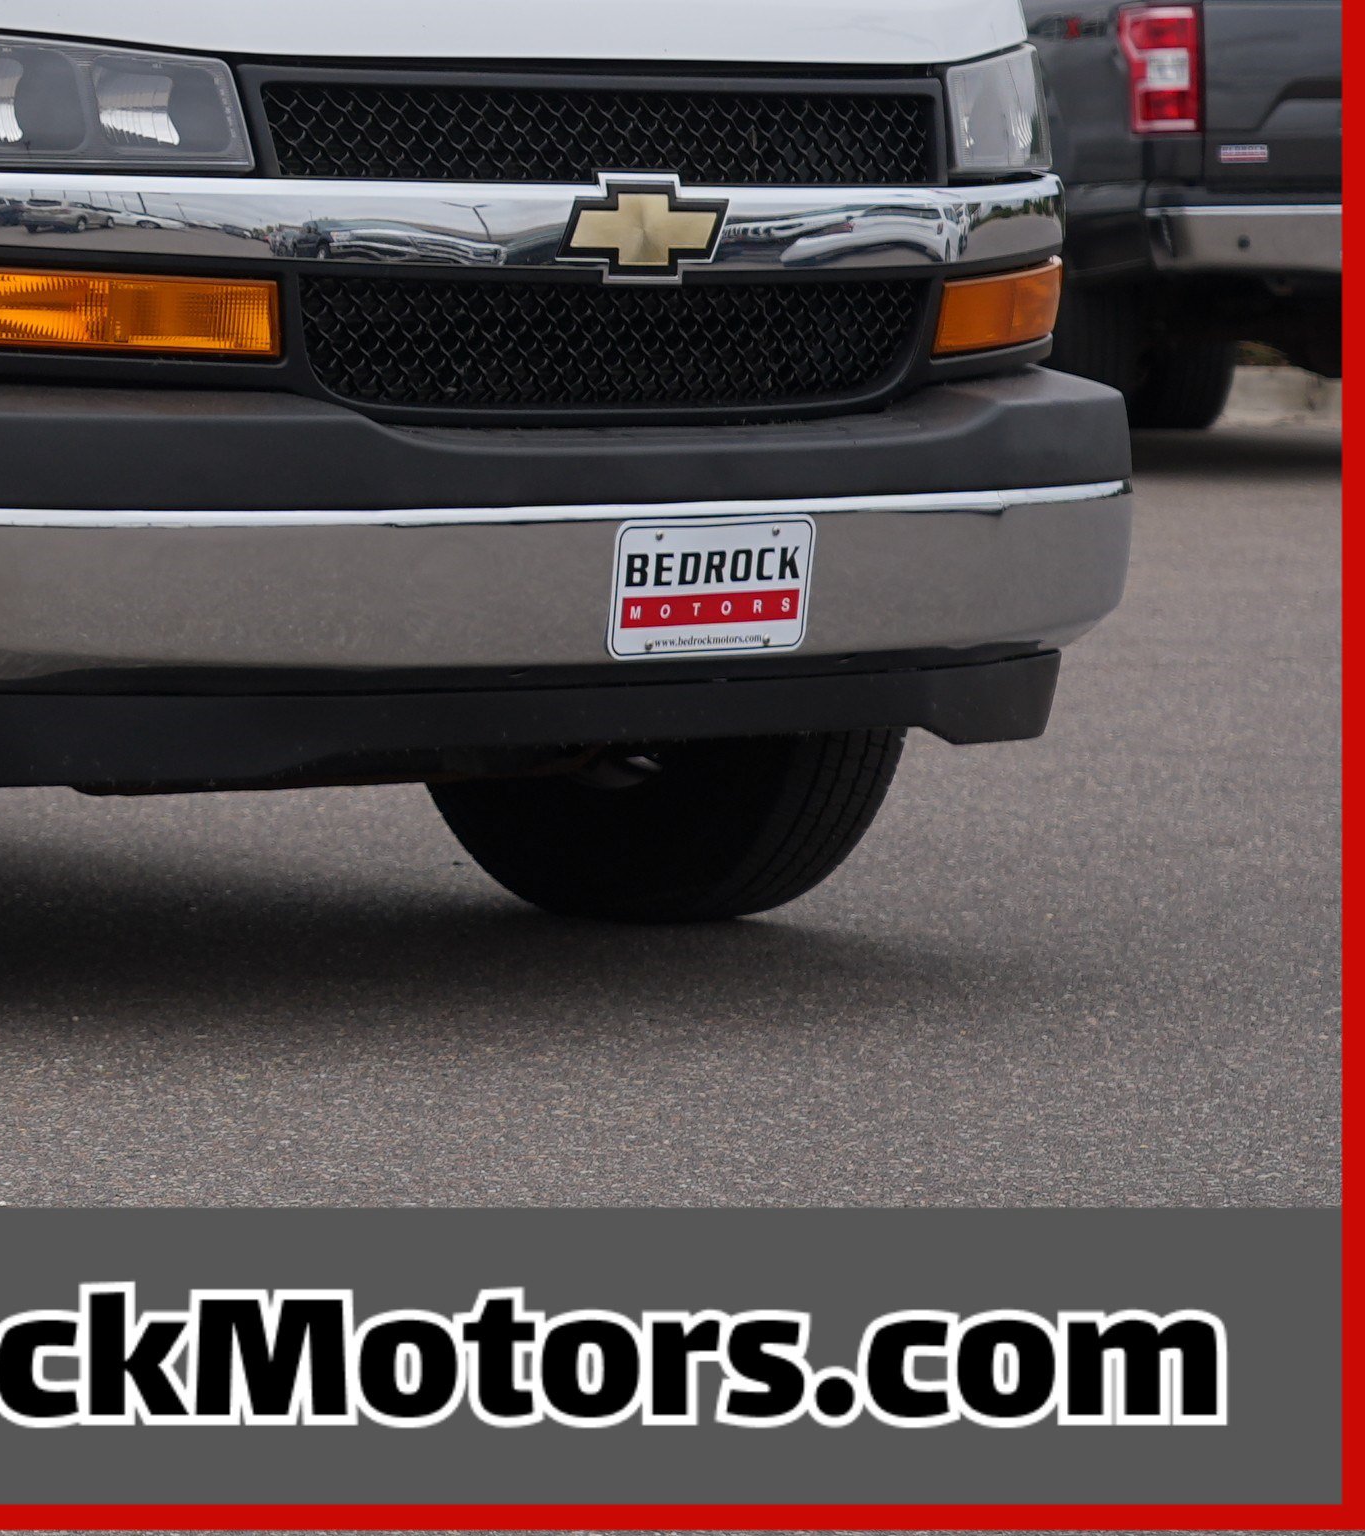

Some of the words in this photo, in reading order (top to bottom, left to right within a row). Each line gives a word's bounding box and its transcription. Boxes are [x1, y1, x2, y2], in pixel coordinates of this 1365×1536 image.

[625, 545, 800, 587] BEDROCK
[629, 598, 791, 620] MOTORS
[654, 633, 763, 648] www.bedrockmotors.com
